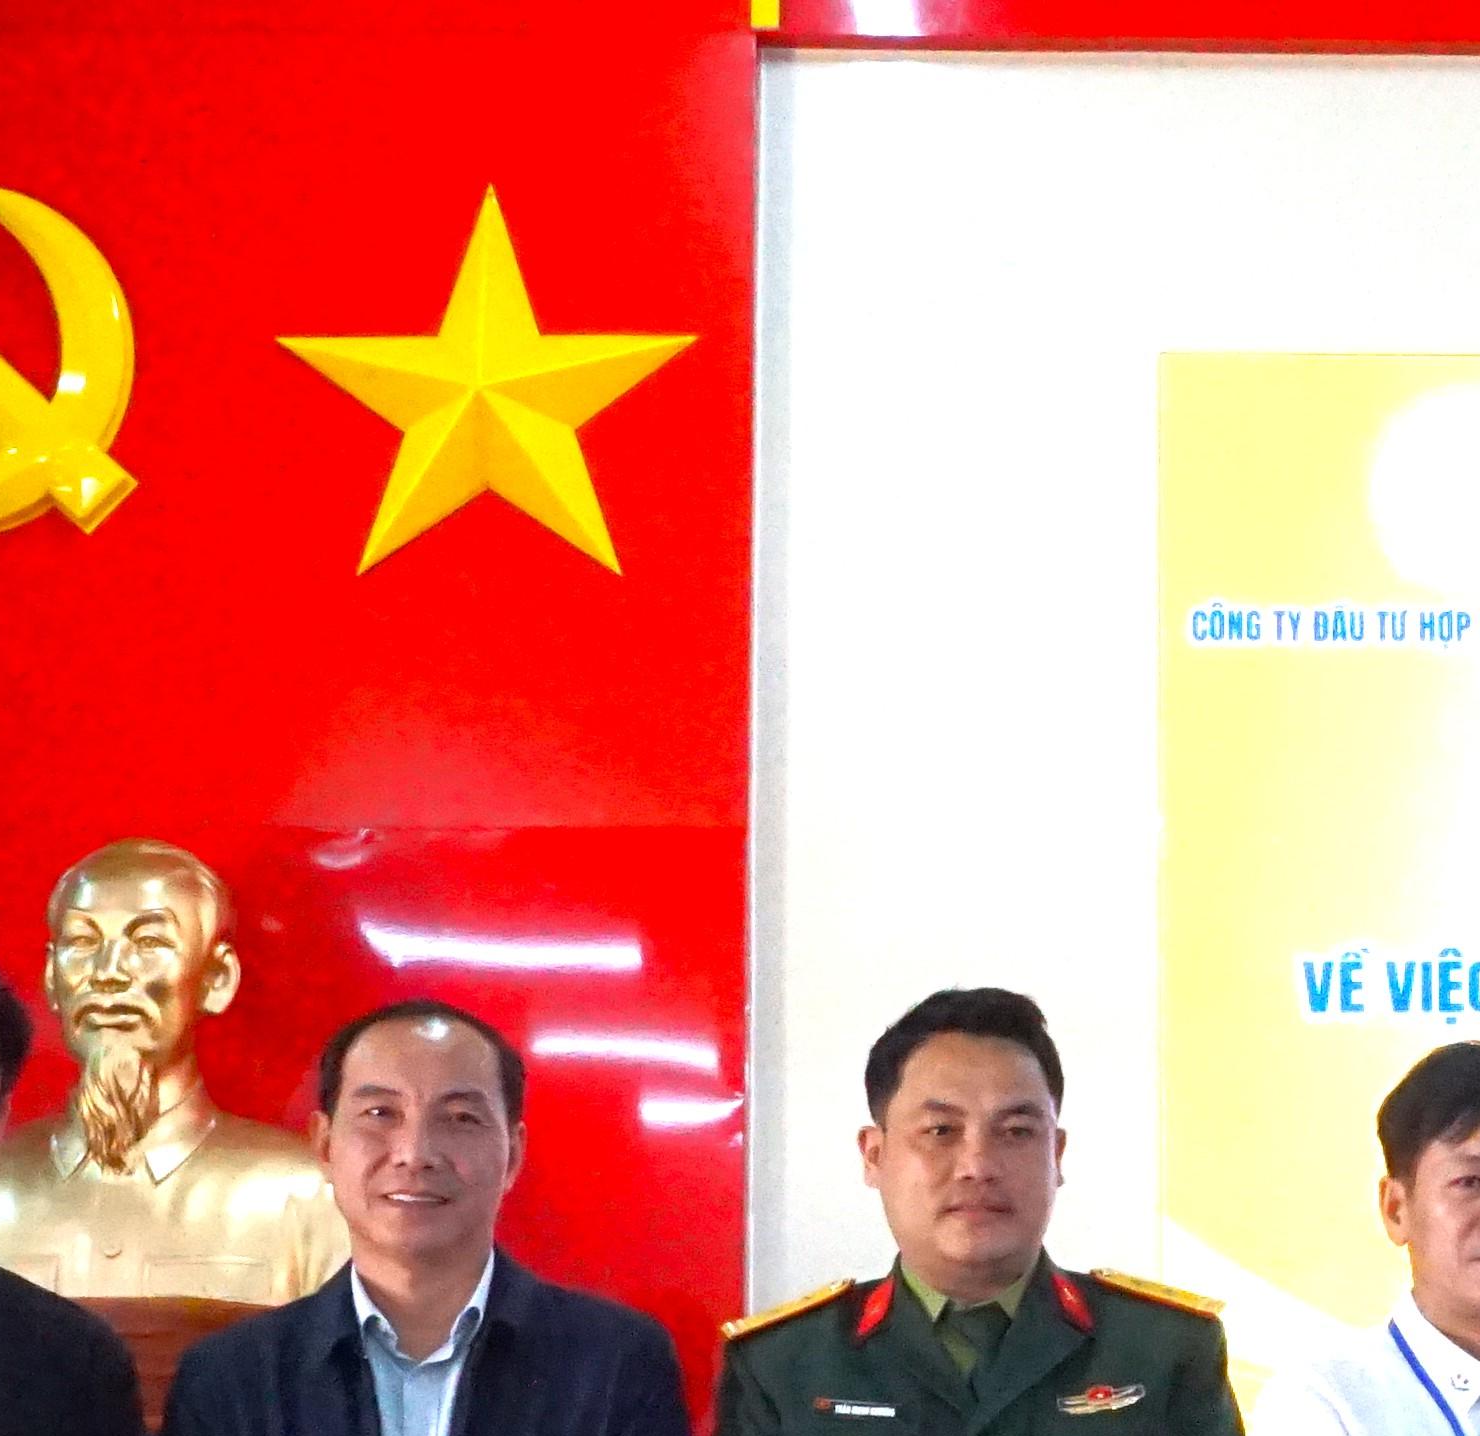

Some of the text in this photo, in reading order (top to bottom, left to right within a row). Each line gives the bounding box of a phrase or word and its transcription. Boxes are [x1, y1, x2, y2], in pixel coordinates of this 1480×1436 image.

[1192, 602, 1262, 642] CÔNG
[1272, 610, 1302, 642] TY
[1376, 609, 1408, 642] TƯ
[1419, 609, 1472, 649] HỢP
[1302, 946, 1371, 1013] VỀ
